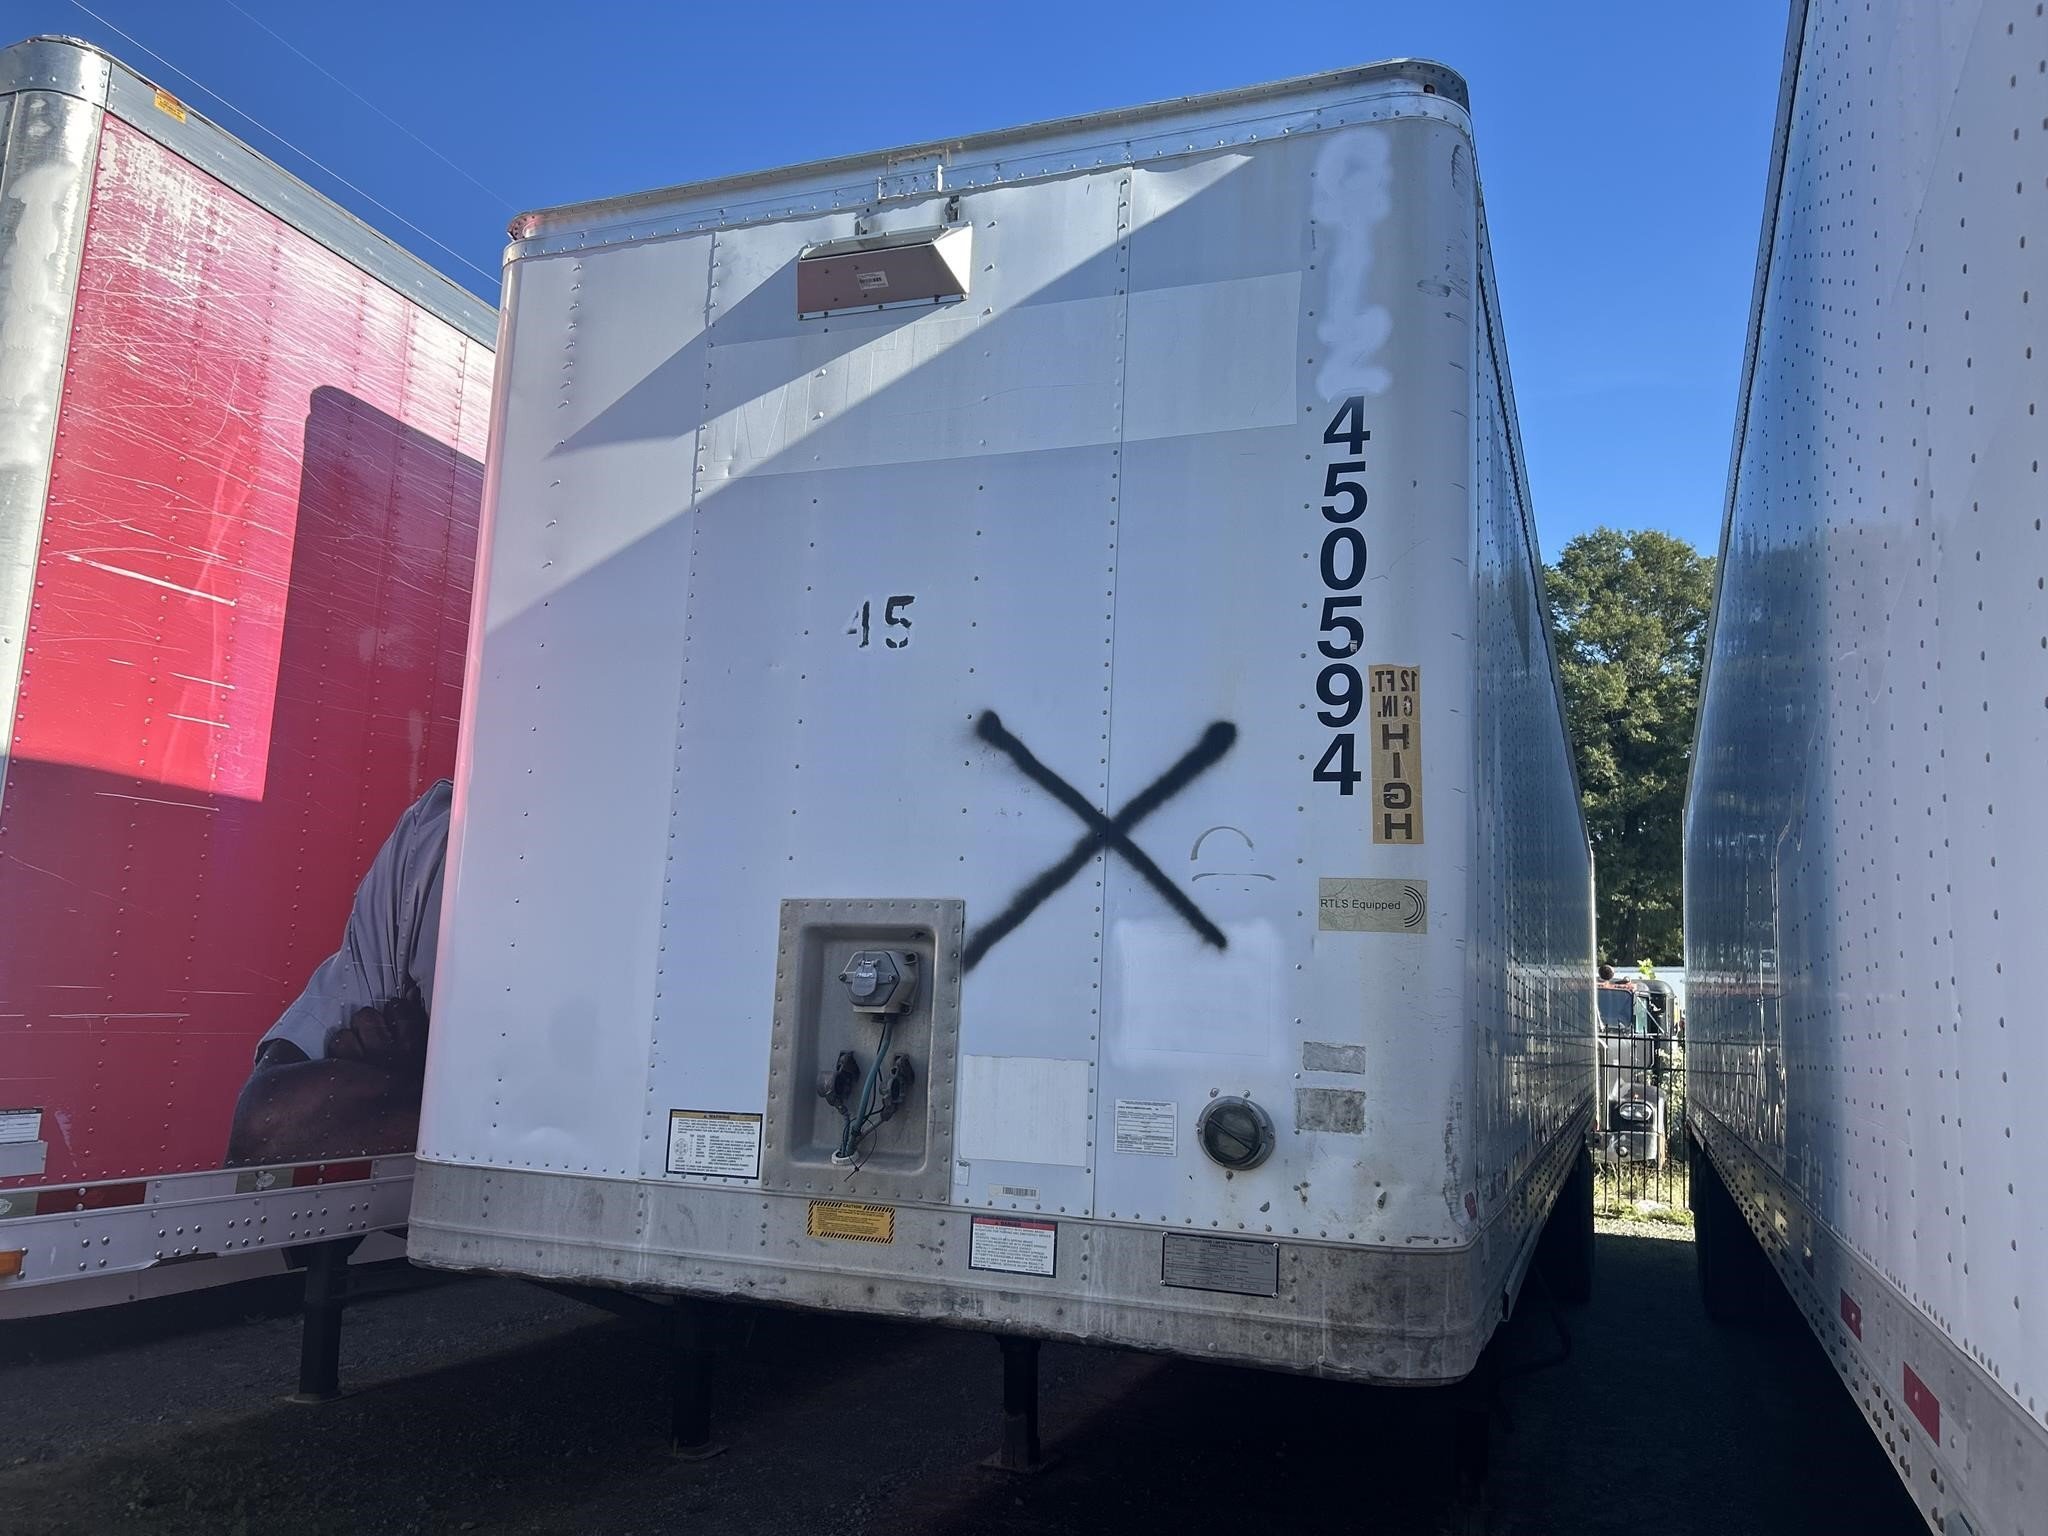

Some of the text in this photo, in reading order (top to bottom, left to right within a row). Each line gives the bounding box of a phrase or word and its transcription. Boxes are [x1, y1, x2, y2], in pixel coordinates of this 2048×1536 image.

[1313, 396, 1371, 795] 450594
[1320, 899, 1401, 911] RTLS Equipped
